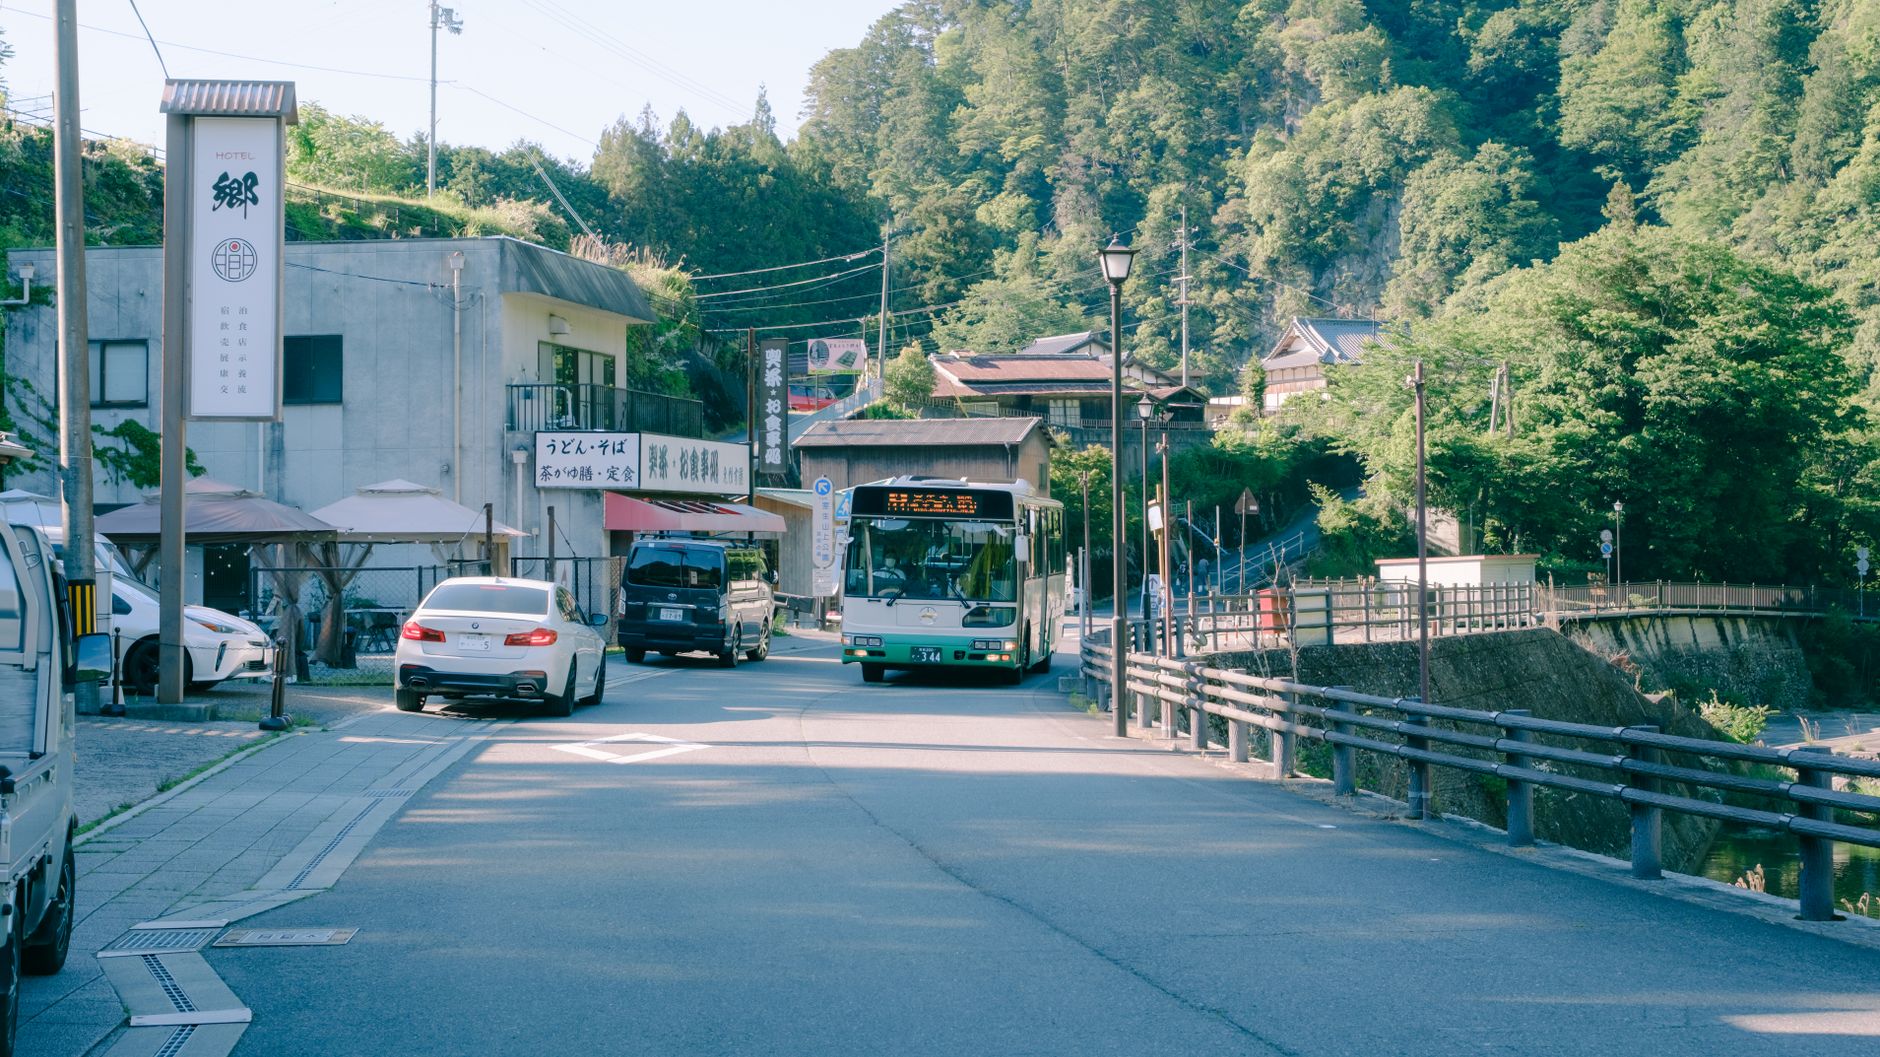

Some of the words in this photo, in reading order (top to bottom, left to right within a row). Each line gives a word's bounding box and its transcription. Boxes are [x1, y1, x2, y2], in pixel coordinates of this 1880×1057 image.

[215, 151, 256, 161] HOTEL
[212, 171, 259, 220] 郷
[220, 321, 248, 331] 飲食
[220, 384, 248, 394] 交流
[546, 438, 628, 456] うどん・そば
[539, 465, 636, 482] 茶がゆ膳・定食
